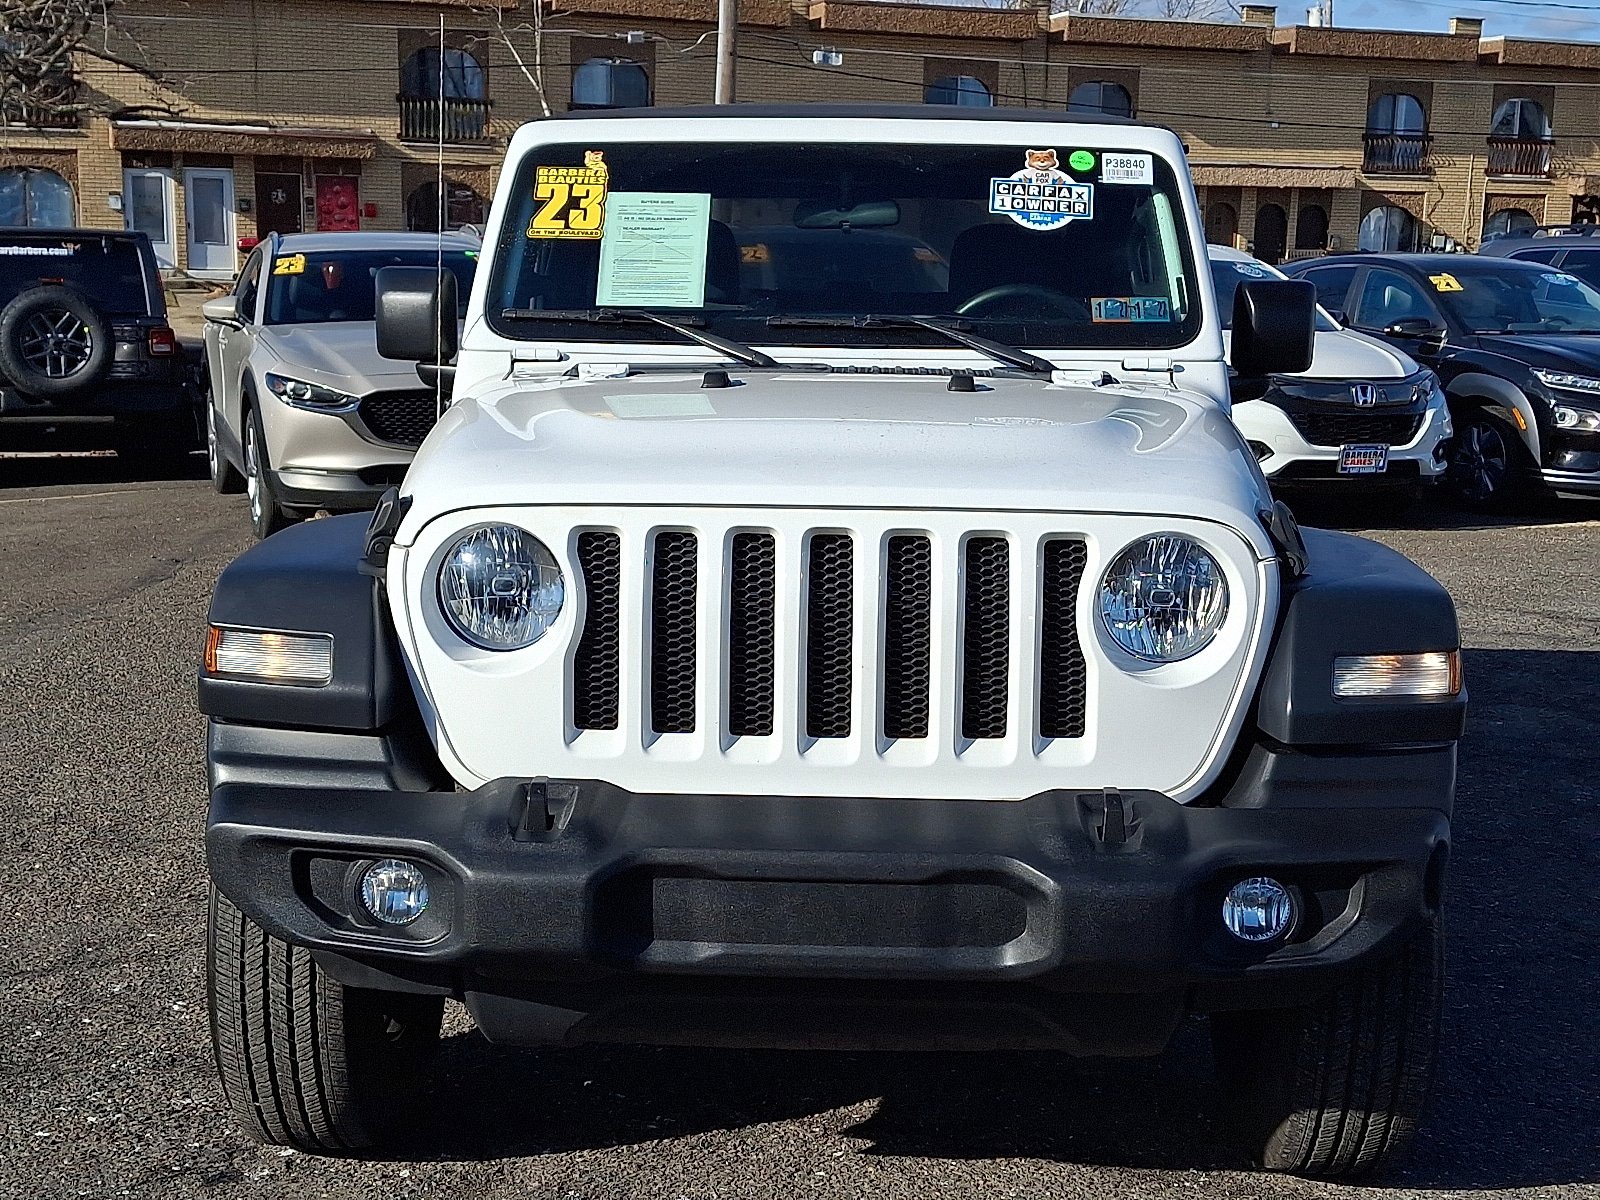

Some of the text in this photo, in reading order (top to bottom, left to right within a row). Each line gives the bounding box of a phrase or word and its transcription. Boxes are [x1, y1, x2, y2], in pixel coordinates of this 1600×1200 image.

[1105, 158, 1145, 169] P38840
[538, 168, 606, 177] BARBERA
[538, 176, 606, 184] BEAUTIES
[998, 183, 1085, 200] CARFAX
[532, 183, 604, 230] 23
[999, 198, 1085, 214] 1 OWNER
